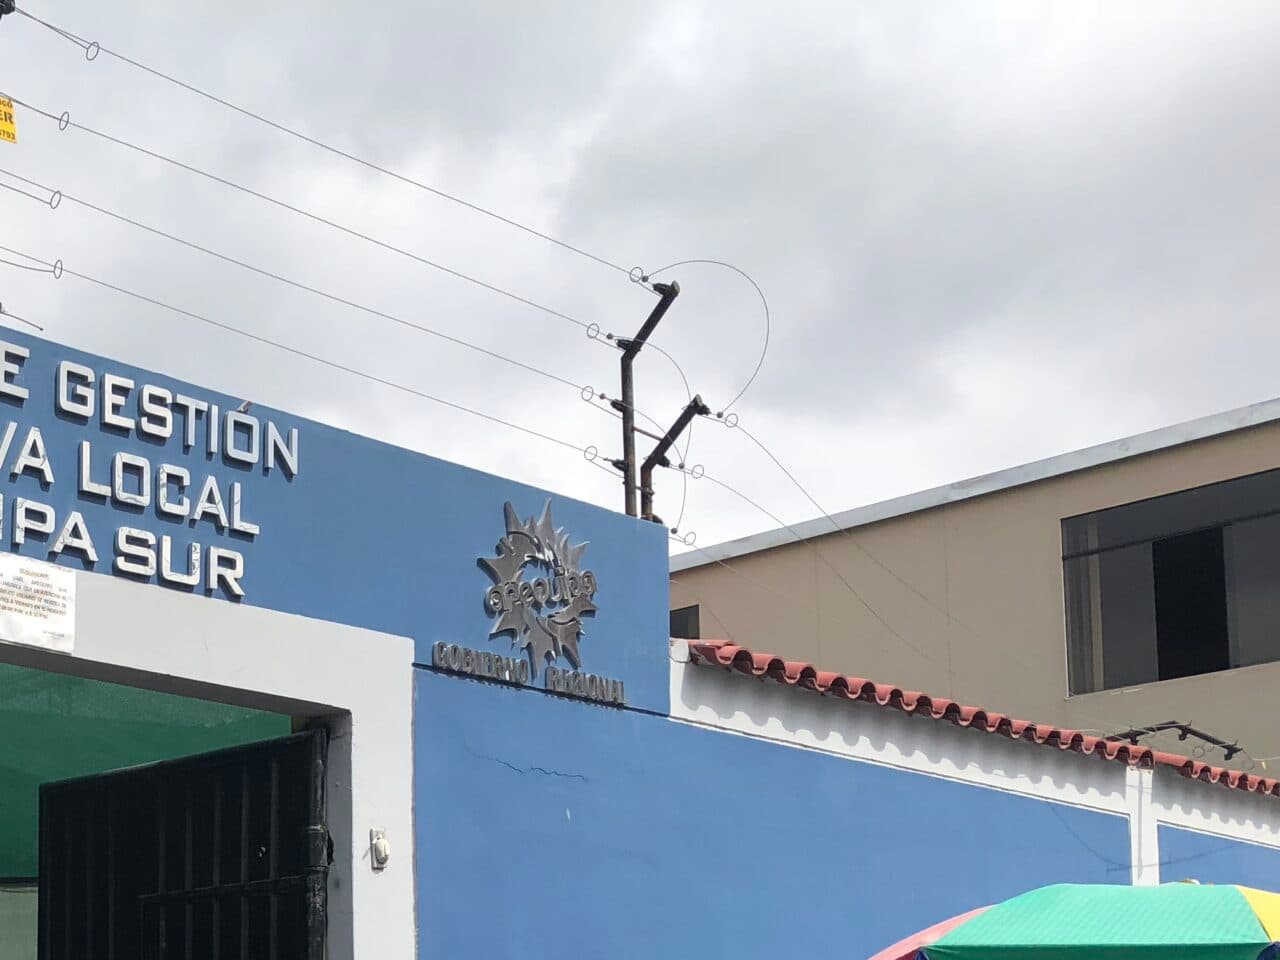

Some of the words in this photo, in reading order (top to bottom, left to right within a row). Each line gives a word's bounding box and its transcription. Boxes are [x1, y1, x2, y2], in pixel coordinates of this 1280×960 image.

[55, 360, 300, 477] GESTIÓN
[78, 440, 261, 536] LOCAL
[115, 526, 246, 597] SUR
